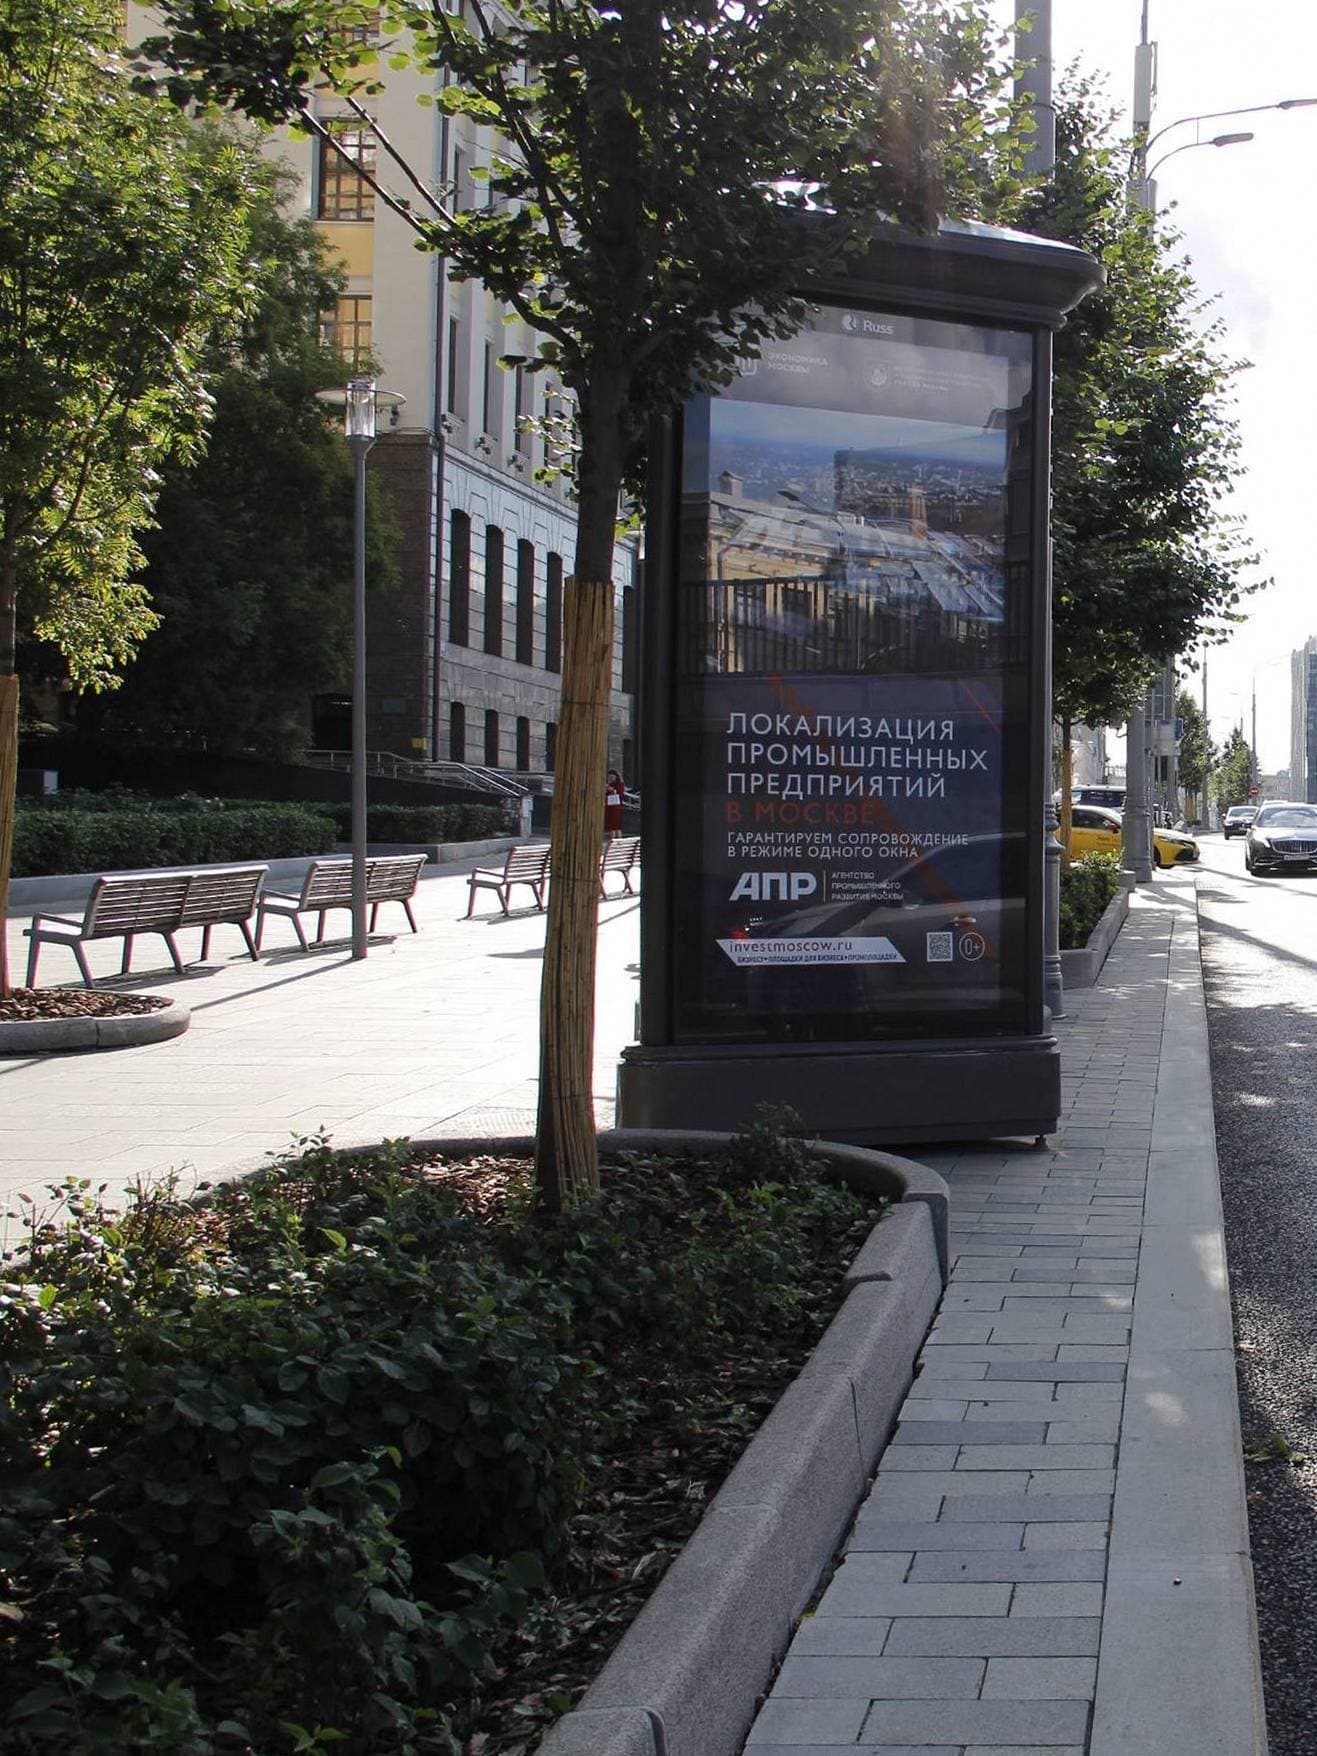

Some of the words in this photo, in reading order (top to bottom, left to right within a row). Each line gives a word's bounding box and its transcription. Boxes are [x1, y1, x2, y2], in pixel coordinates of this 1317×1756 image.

[863, 319, 895, 336] Russ
[726, 712, 954, 744] ЛОКАЛИЗАЦИЯ
[727, 742, 988, 771] ПРОМЫШЛЕННЫХ
[727, 772, 945, 800] ПРЕДПРИЯТИЙ
[727, 802, 742, 824] В
[754, 801, 875, 825] МОСКВЕ
[727, 831, 832, 844] ГАРАНТИРУЕМ
[838, 832, 969, 848] СОПРОВОЖДЕНИЕ
[727, 846, 736, 857] В
[741, 846, 802, 858] РЕЖИМЕ
[808, 847, 873, 860] ОДНОГО
[879, 846, 919, 858] ОКНА
[831, 872, 875, 880] АГЕНТСТВО
[729, 872, 817, 901] АПР
[729, 940, 853, 953] investmoscow.ru
[964, 938, 981, 955] 0+
